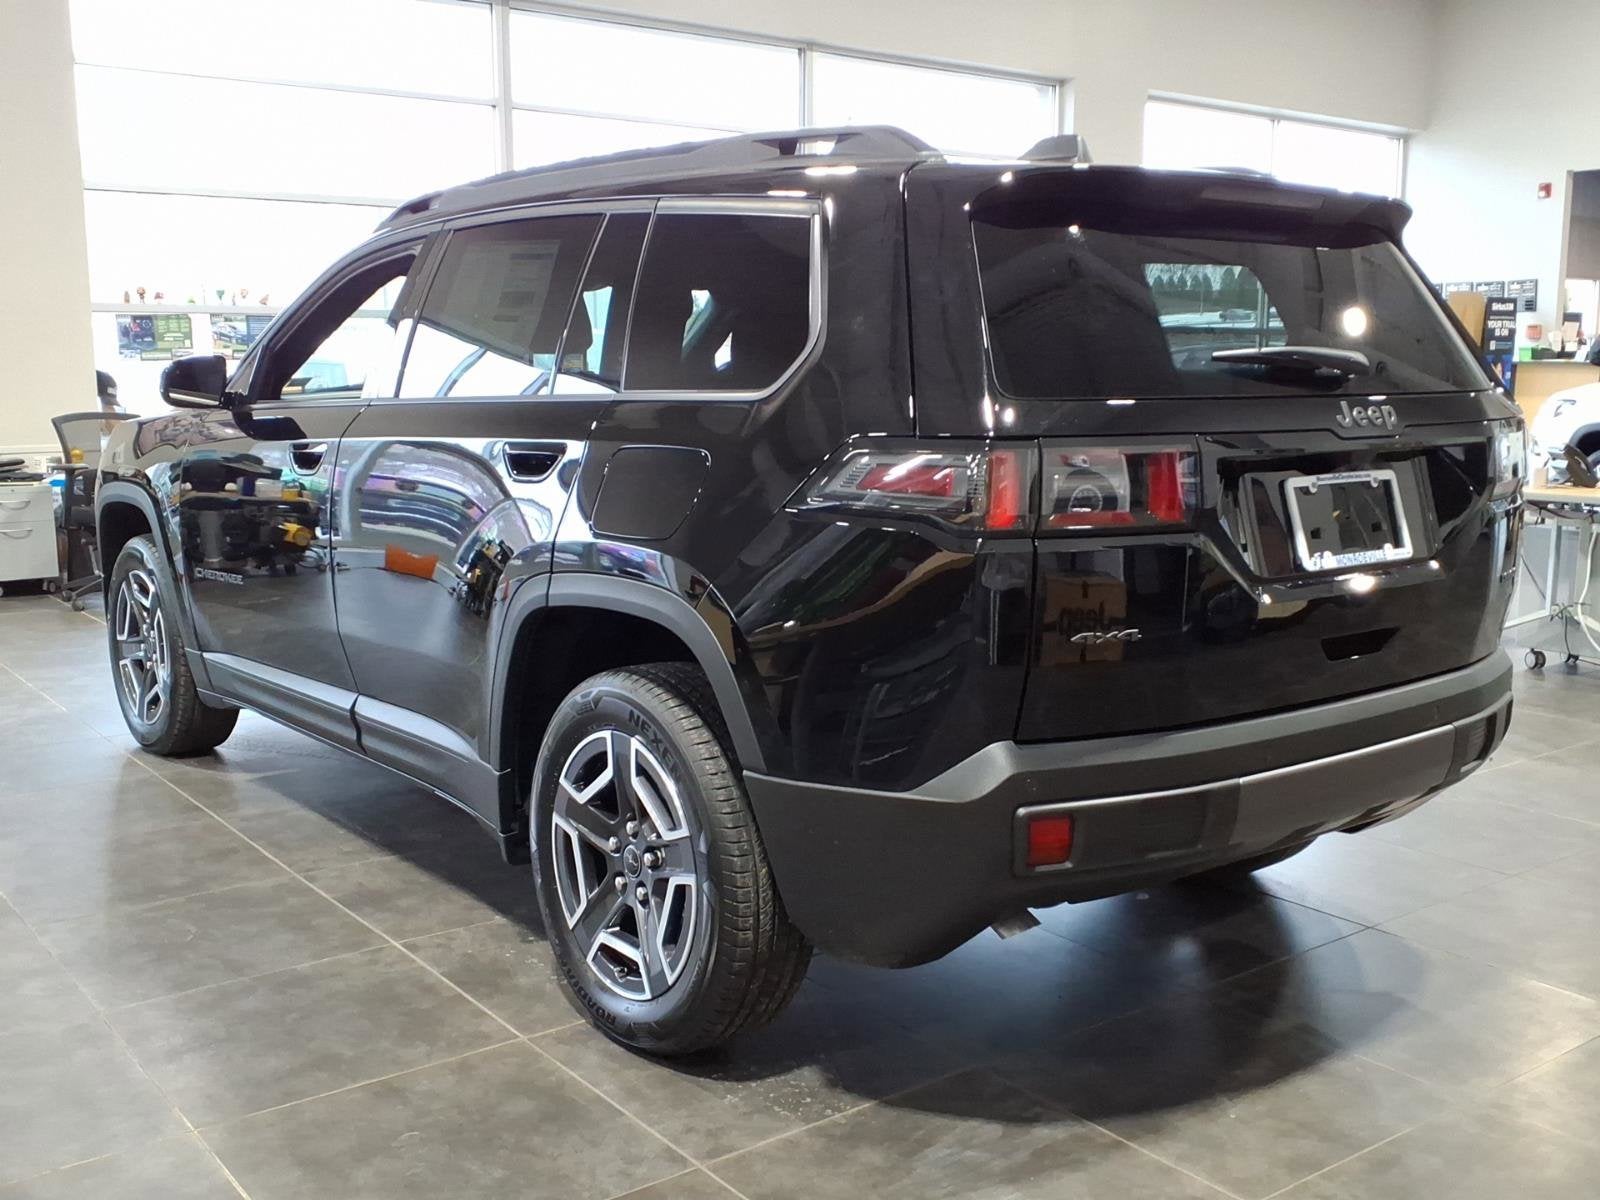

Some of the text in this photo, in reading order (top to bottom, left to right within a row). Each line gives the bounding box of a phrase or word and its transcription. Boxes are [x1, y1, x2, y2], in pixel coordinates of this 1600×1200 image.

[1487, 320, 1516, 329] YOUR TRIAL
[1336, 400, 1398, 430] Jeep
[194, 567, 244, 585] CHEROKEE
[628, 709, 682, 778] NEXEN
